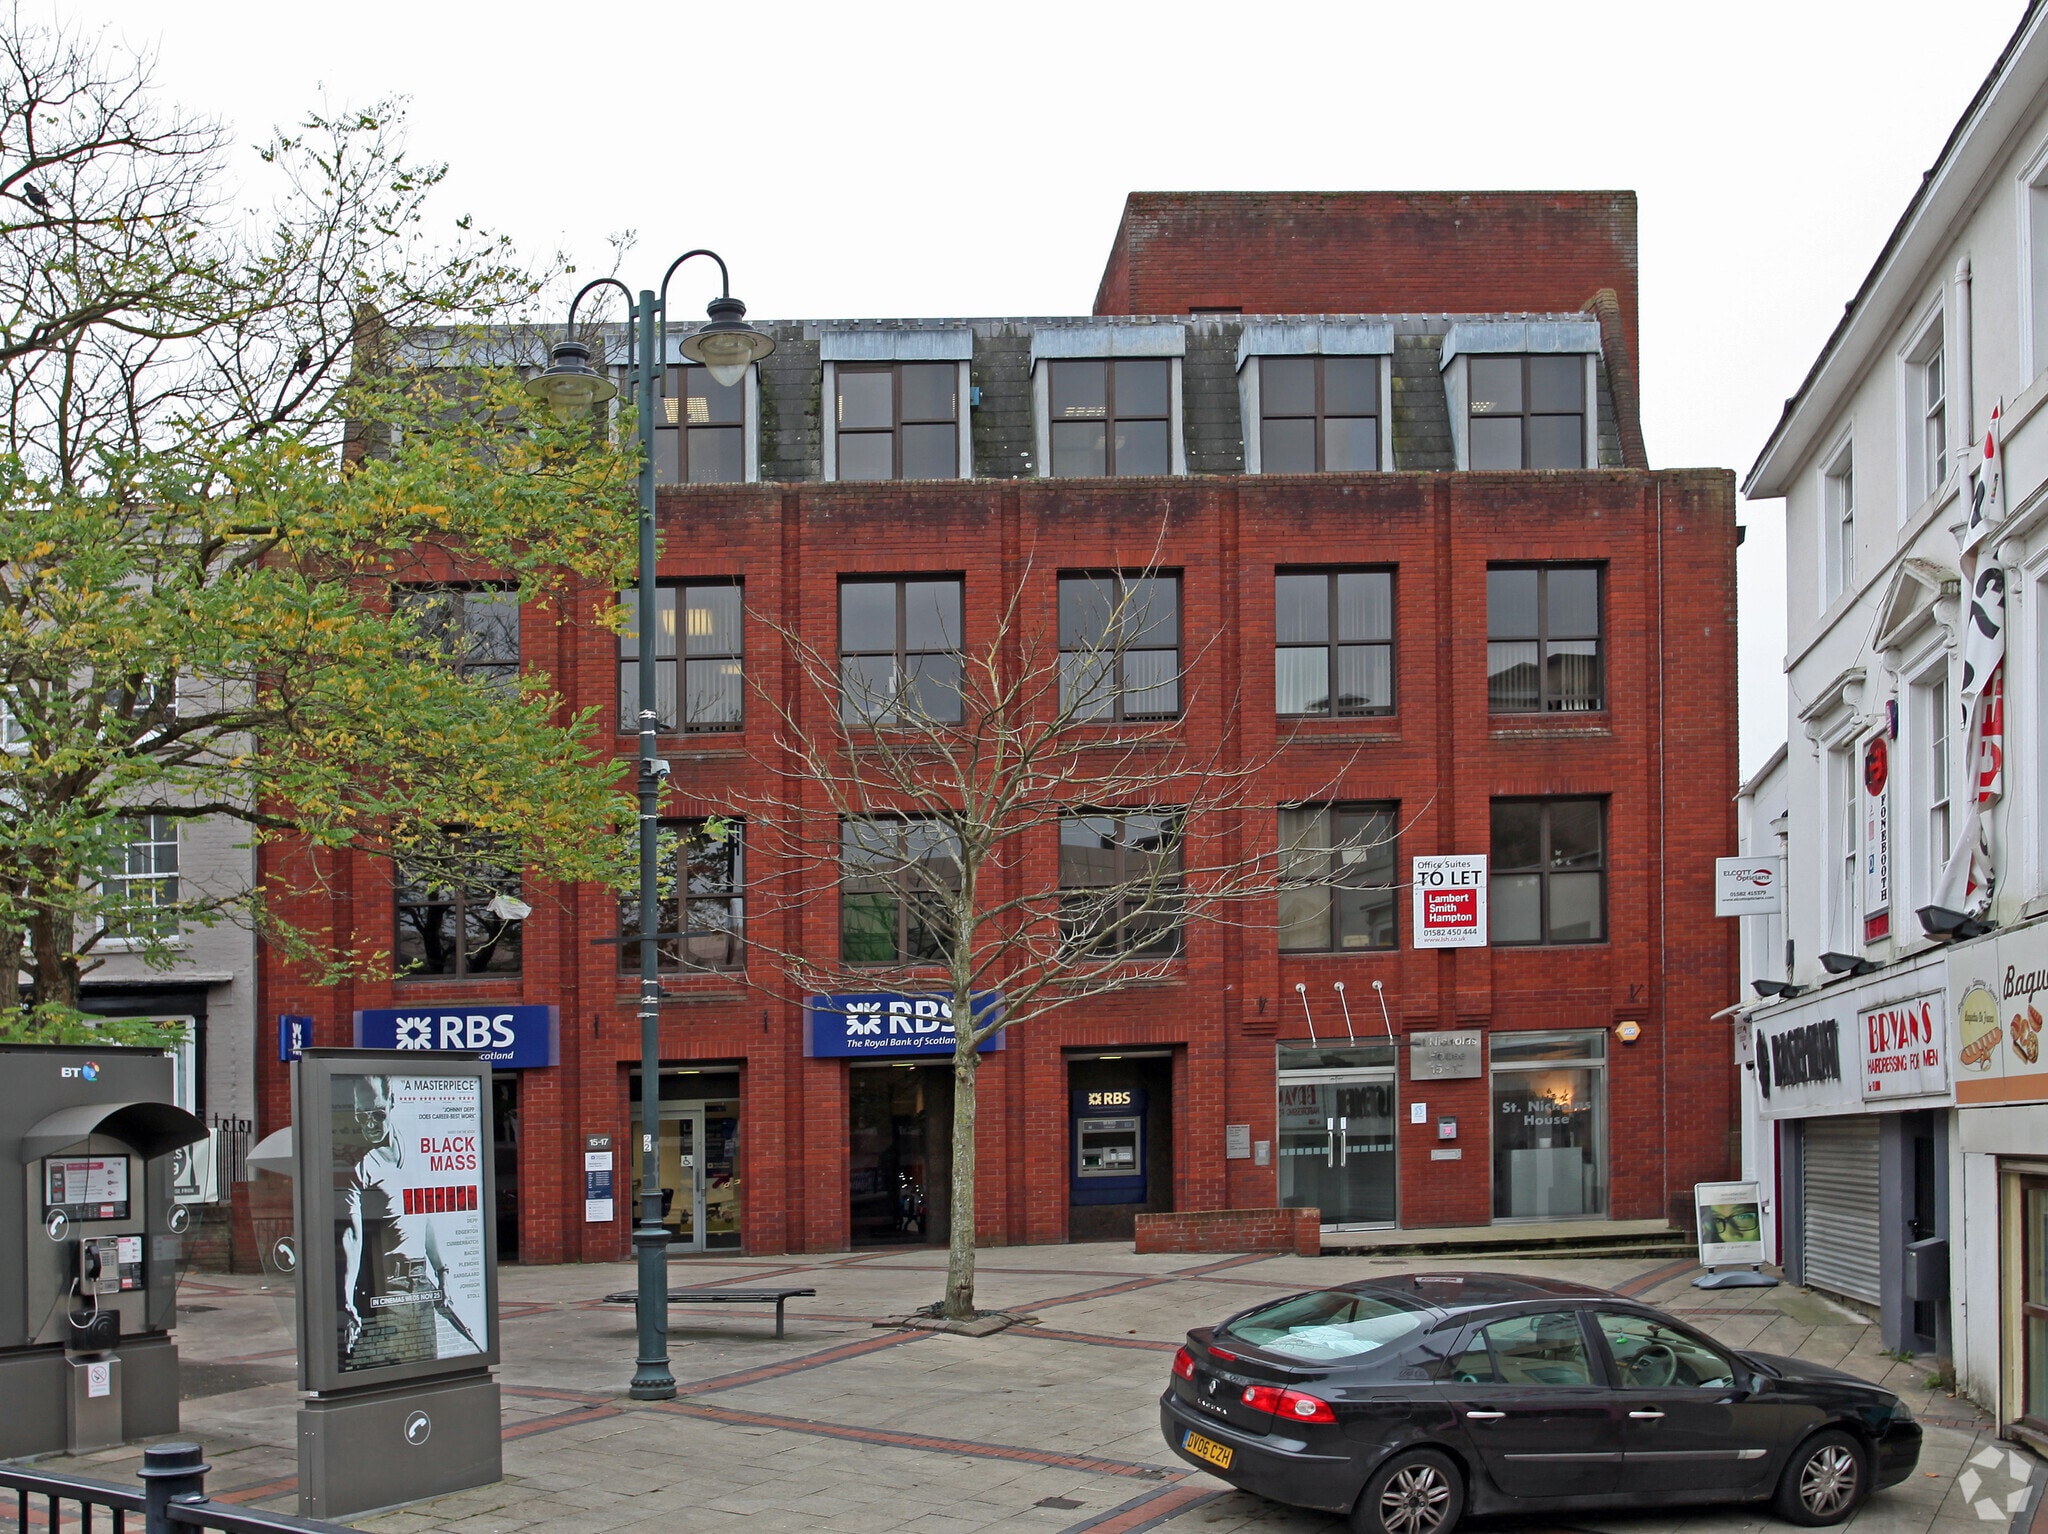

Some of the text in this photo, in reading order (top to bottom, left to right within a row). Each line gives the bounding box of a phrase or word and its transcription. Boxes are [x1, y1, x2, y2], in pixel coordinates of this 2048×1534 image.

[1880, 793, 1888, 901] FONEBOOTH
[1417, 860, 1471, 869] Office Suites
[1418, 870, 1482, 886] TO LET
[1723, 869, 1752, 877] ELCOTT
[1736, 874, 1770, 882] Opticians
[1429, 893, 1469, 903] Lambert
[1429, 904, 1457, 913] Smith
[1429, 914, 1472, 923] Hampton
[889, 1000, 956, 1034] RBS
[439, 1014, 515, 1049] RBS
[1867, 1000, 1932, 1053] BRYAN'S
[847, 1036, 956, 1049] The Royal Bank of Scotlan
[1429, 1036, 1477, 1047] Nicholas
[479, 1051, 514, 1060] cotland
[1867, 1055, 1907, 1075] HAIRDRESSING
[1923, 1048, 1938, 1067] MEN
[61, 1067, 81, 1078] BT
[1104, 1092, 1131, 1105] RBS
[1502, 1100, 1591, 1113] St. Nicholas
[1524, 1116, 1570, 1126] House
[420, 1136, 475, 1154] BLACK
[589, 1138, 609, 1146] 15-17
[430, 1154, 476, 1171] MASS
[380, 1296, 404, 1305] CINEMAS
[1187, 1433, 1231, 1464] DV06 CZH
